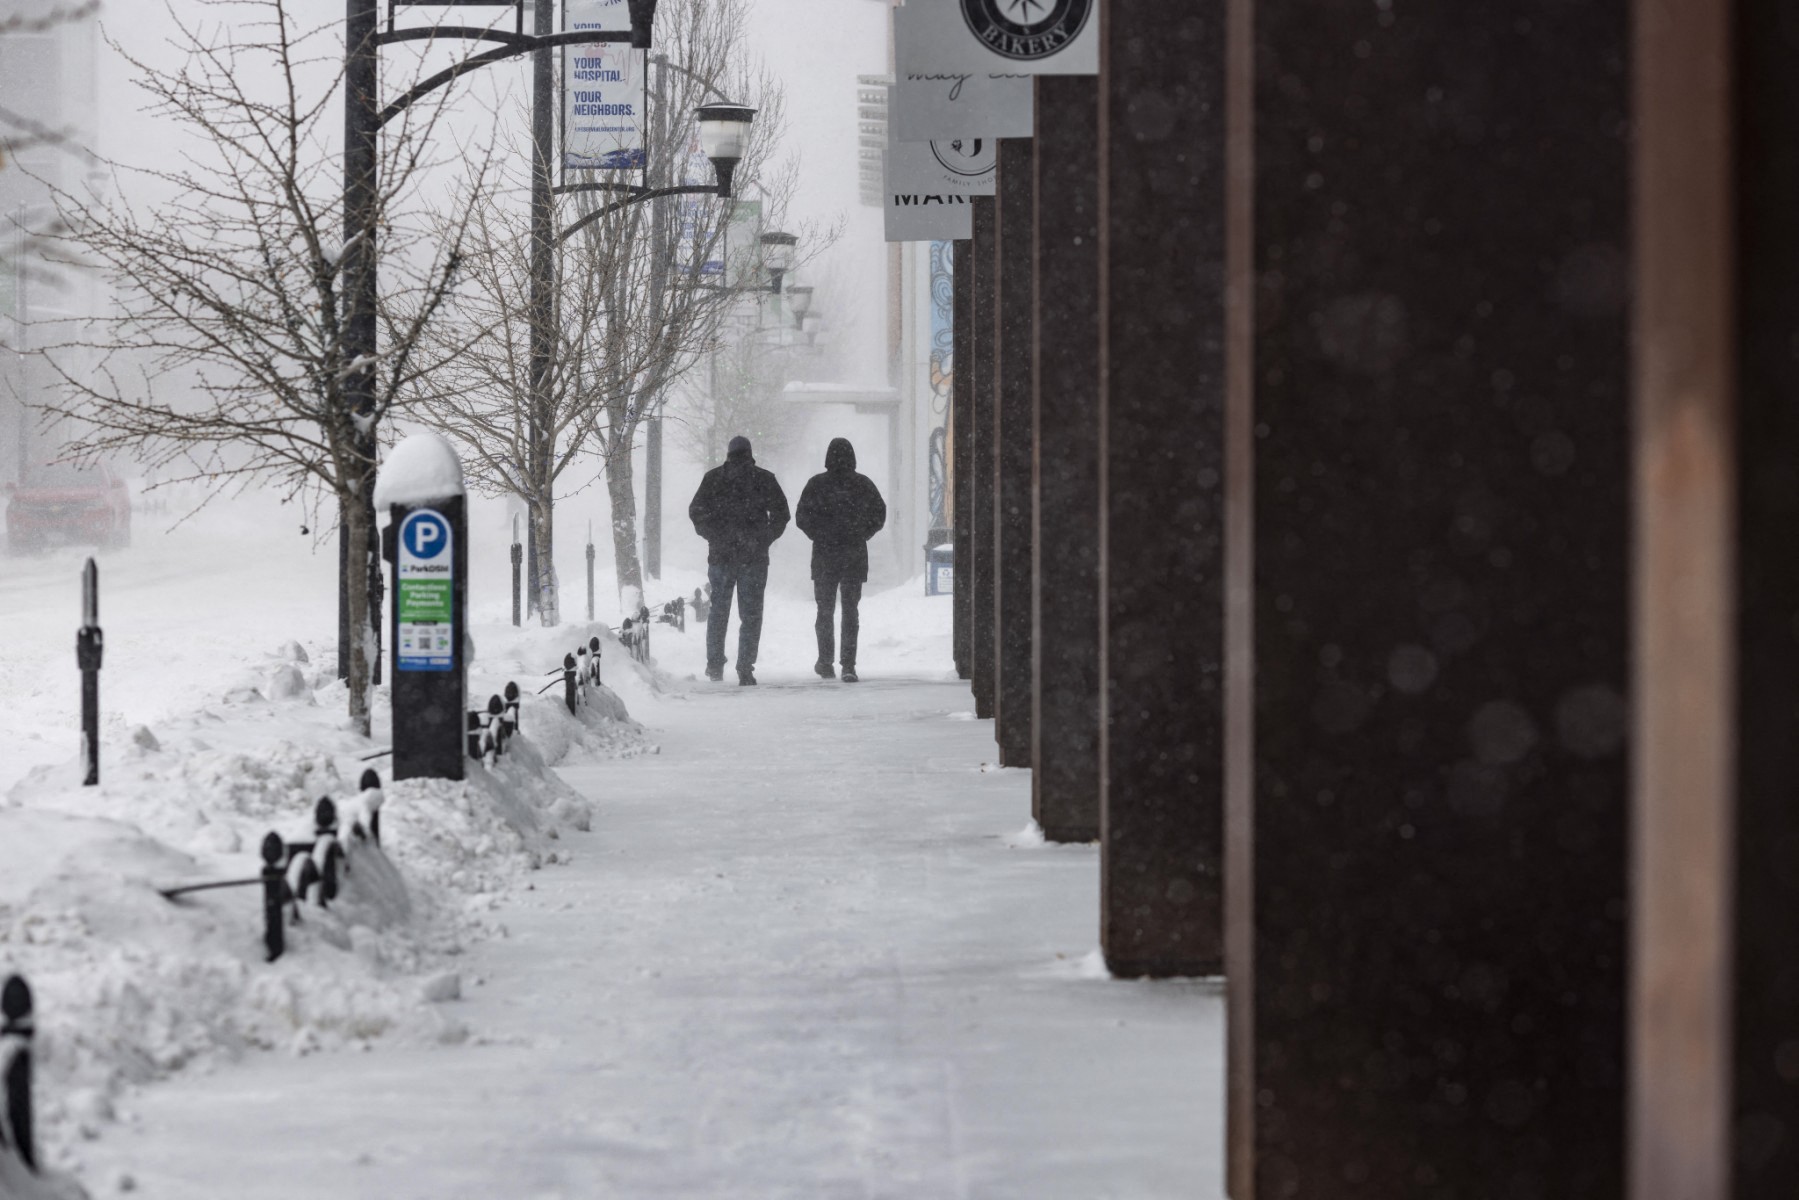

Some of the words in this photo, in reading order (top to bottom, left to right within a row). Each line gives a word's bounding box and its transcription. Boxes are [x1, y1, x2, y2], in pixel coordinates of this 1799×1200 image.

[982, 23, 1069, 55] BAKERY
[573, 57, 602, 69] YOUR
[573, 91, 602, 103] YOUR
[573, 104, 636, 116] NEIGHBORS.
[943, 174, 971, 187] FAMILY
[415, 521, 440, 553] P
[401, 583, 448, 591] Contactless
[409, 591, 441, 600] Parking
[406, 600, 444, 609] Payments
